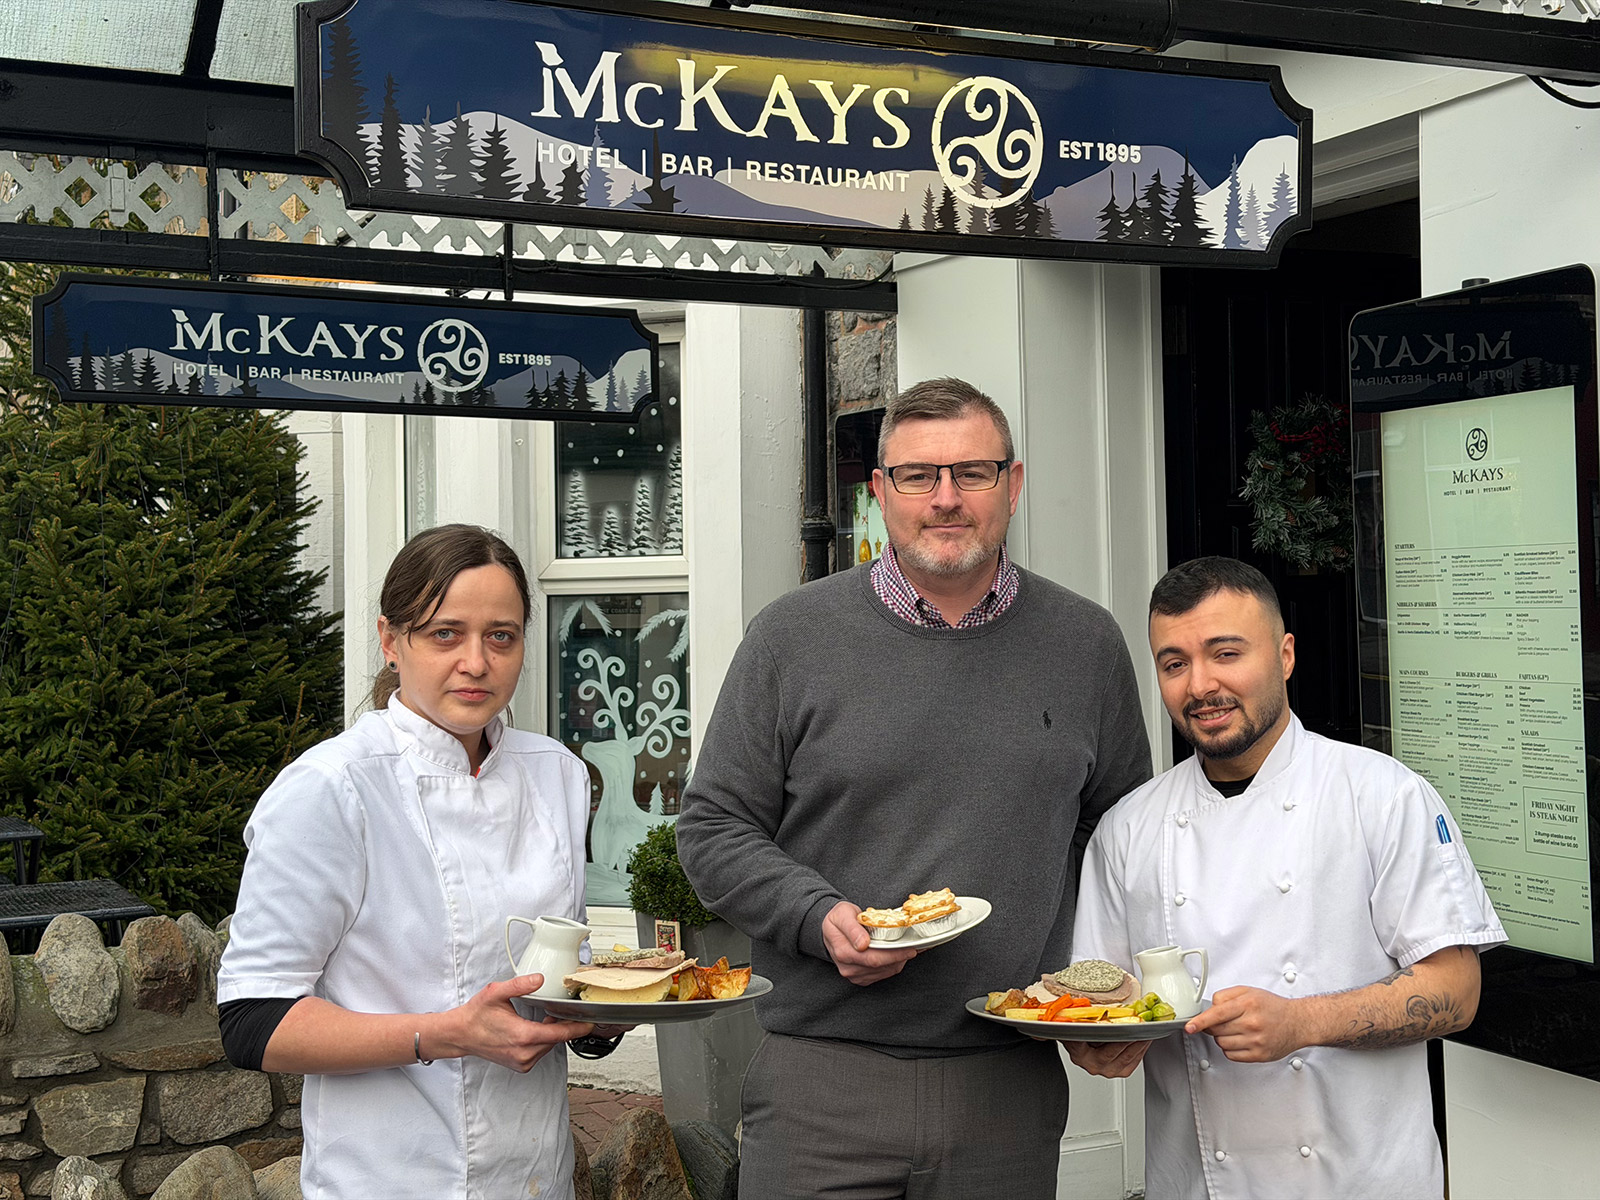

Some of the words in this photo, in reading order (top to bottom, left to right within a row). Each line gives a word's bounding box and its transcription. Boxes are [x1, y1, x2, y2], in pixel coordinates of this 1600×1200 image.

[530, 40, 911, 150] McKAYS
[1059, 140, 1094, 161] EST
[1097, 142, 1142, 164] 1895
[537, 141, 628, 170] HOTEL
[661, 153, 714, 177] BAR
[746, 160, 911, 193] RESTAURANT
[169, 309, 405, 361] McKAYS
[498, 352, 522, 365] EST
[522, 353, 552, 366] 1895
[173, 362, 229, 378] HOTEL
[248, 366, 282, 380] BAR
[301, 368, 405, 385] RESTAURANT
[1529, 810, 1536, 818] IS
[1536, 811, 1557, 821] STEAK
[1558, 814, 1580, 824] NIGHT
[1531, 800, 1554, 811] FRIDAY
[1555, 803, 1577, 813] NIGHT
